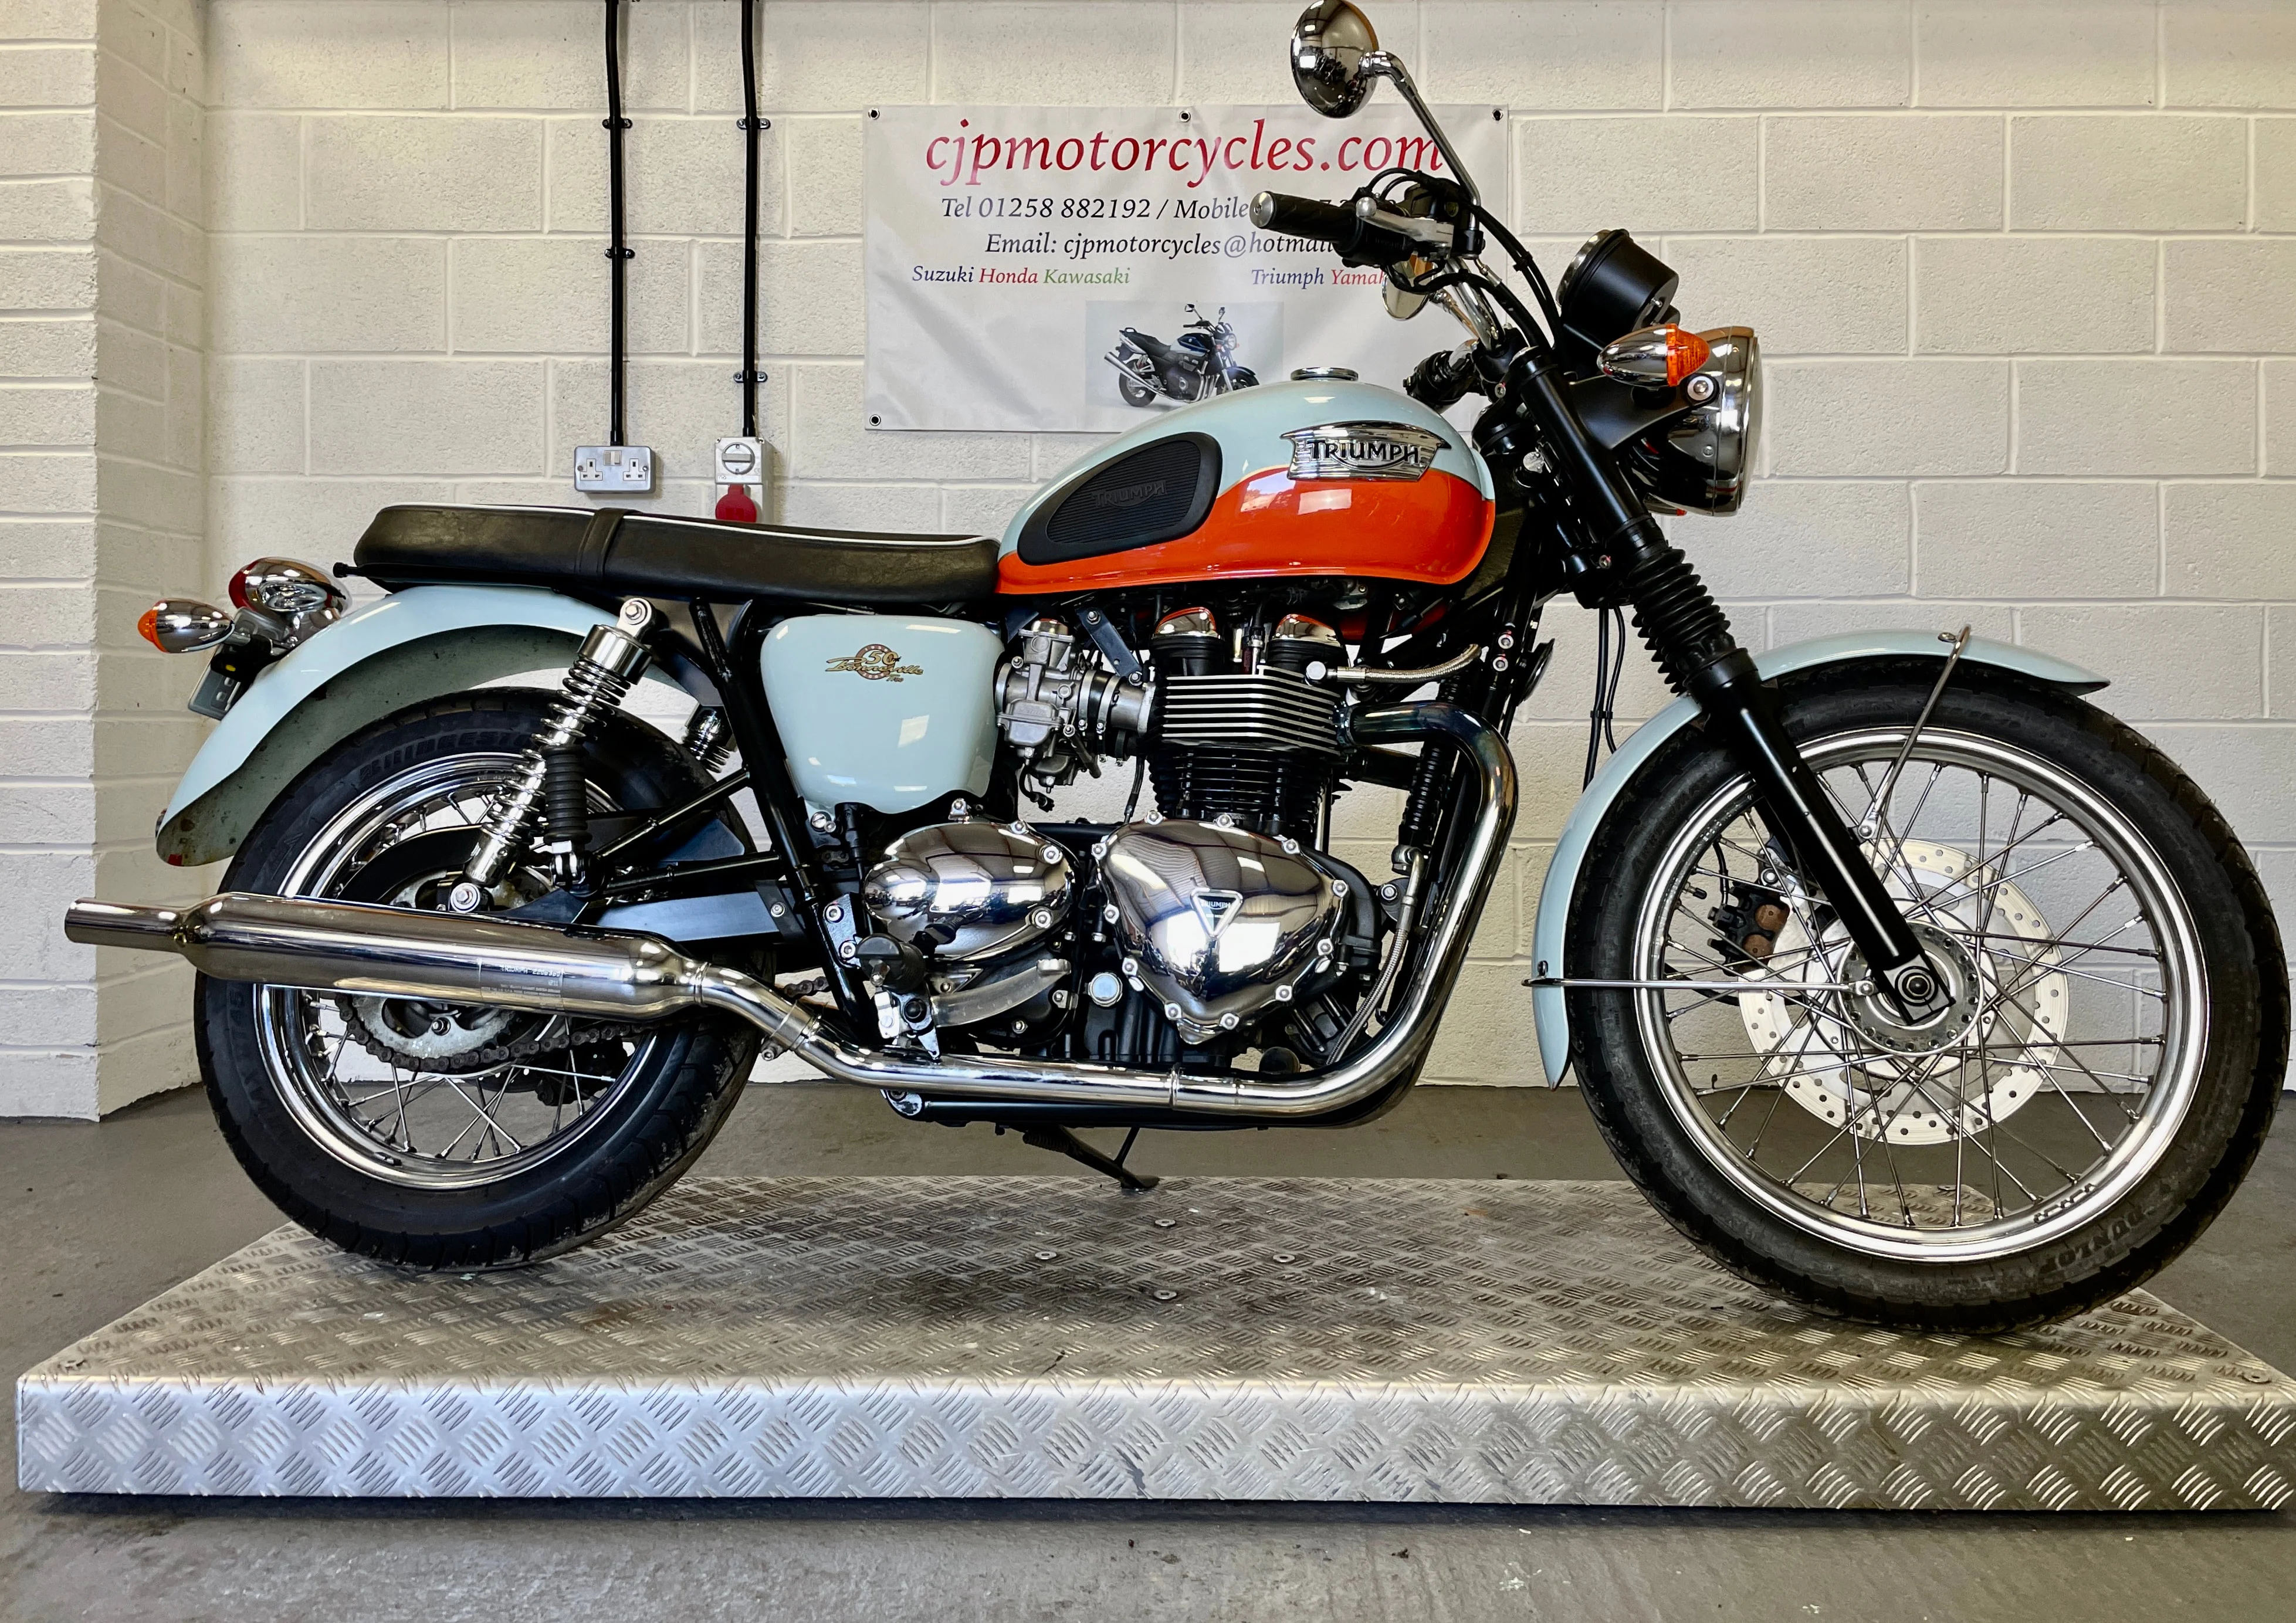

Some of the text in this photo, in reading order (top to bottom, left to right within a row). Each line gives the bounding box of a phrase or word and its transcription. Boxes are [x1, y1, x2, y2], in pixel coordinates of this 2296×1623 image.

[926, 118, 1443, 188] cjpmotorcycles.com
[942, 196, 1248, 220] Tel 01258 882192 / Mobile
[985, 232, 1057, 253] Email:
[912, 266, 1130, 284] Suzuki Honda Kawasaki
[1252, 267, 1383, 289] Triumph Yama
[1307, 440, 1419, 467] TRIUMPH
[1092, 481, 1167, 508] TRIUMPH
[825, 656, 924, 675] Bonneville
[2036, 1207, 2147, 1275] DUNLOP
